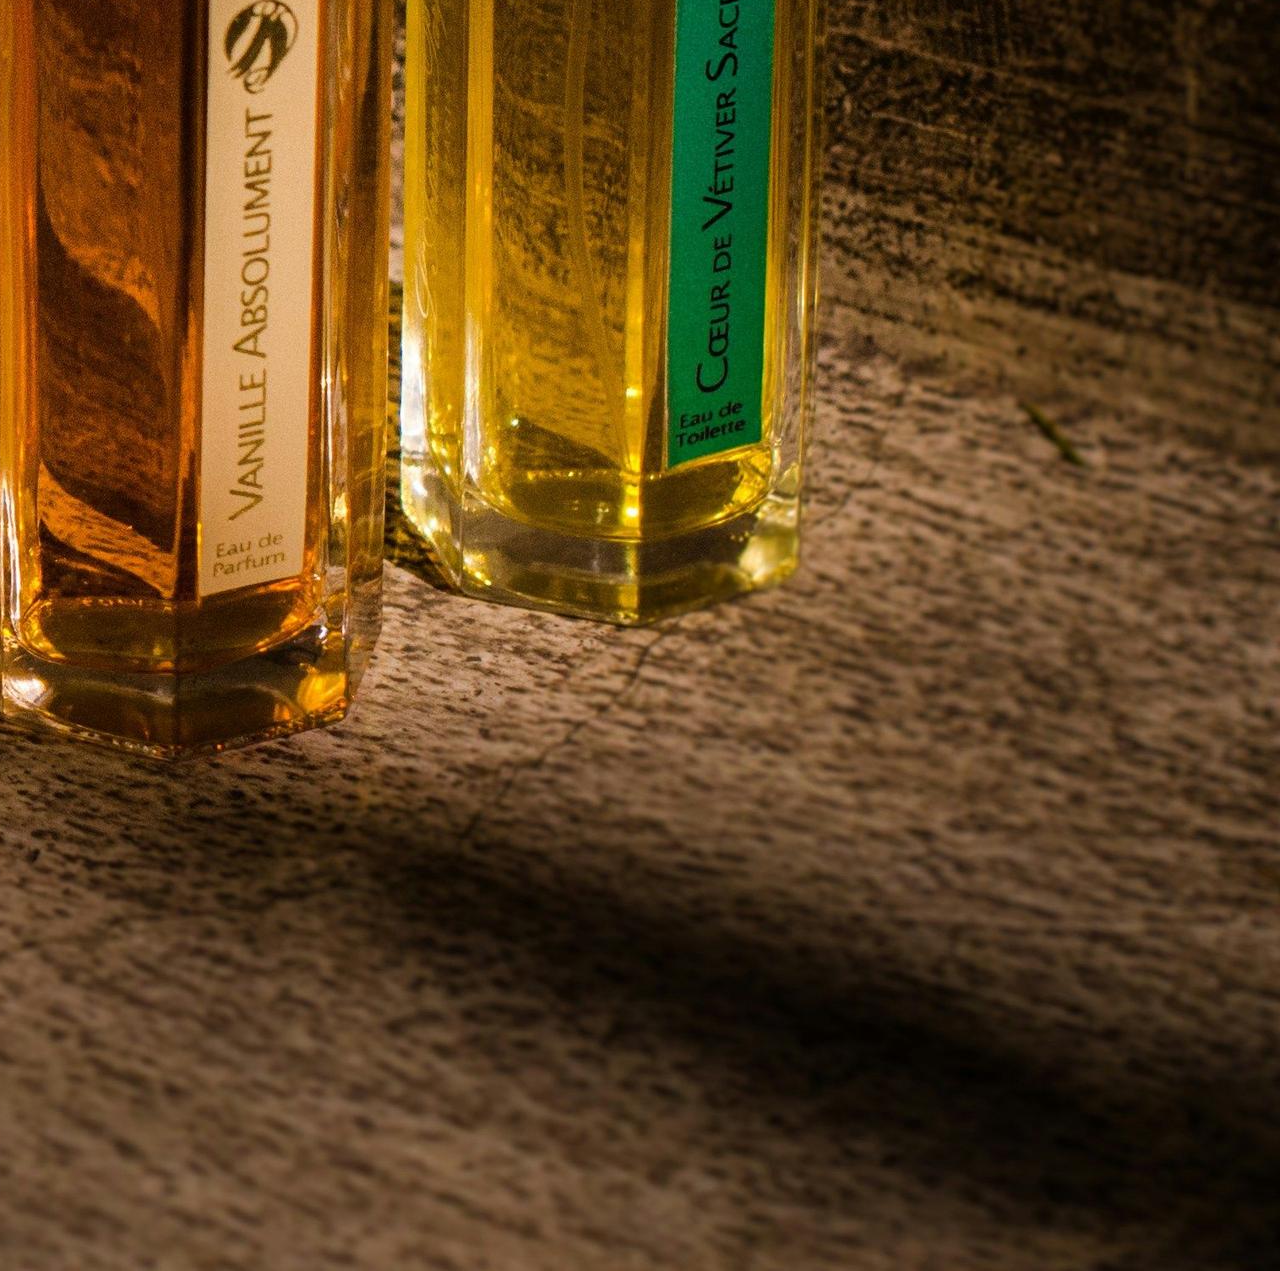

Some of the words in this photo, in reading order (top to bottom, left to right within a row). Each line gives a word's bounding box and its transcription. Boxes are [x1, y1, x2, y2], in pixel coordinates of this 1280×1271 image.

[701, 88, 737, 231] VÉTIVER
[233, 108, 273, 359] ABSOLUMENT
[713, 233, 732, 273] DE
[680, 410, 713, 428] Eau
[719, 401, 743, 418] de
[229, 367, 268, 521] VANILLE
[213, 551, 285, 577] Parfum
[216, 541, 251, 558] Eau
[258, 532, 283, 548] de
